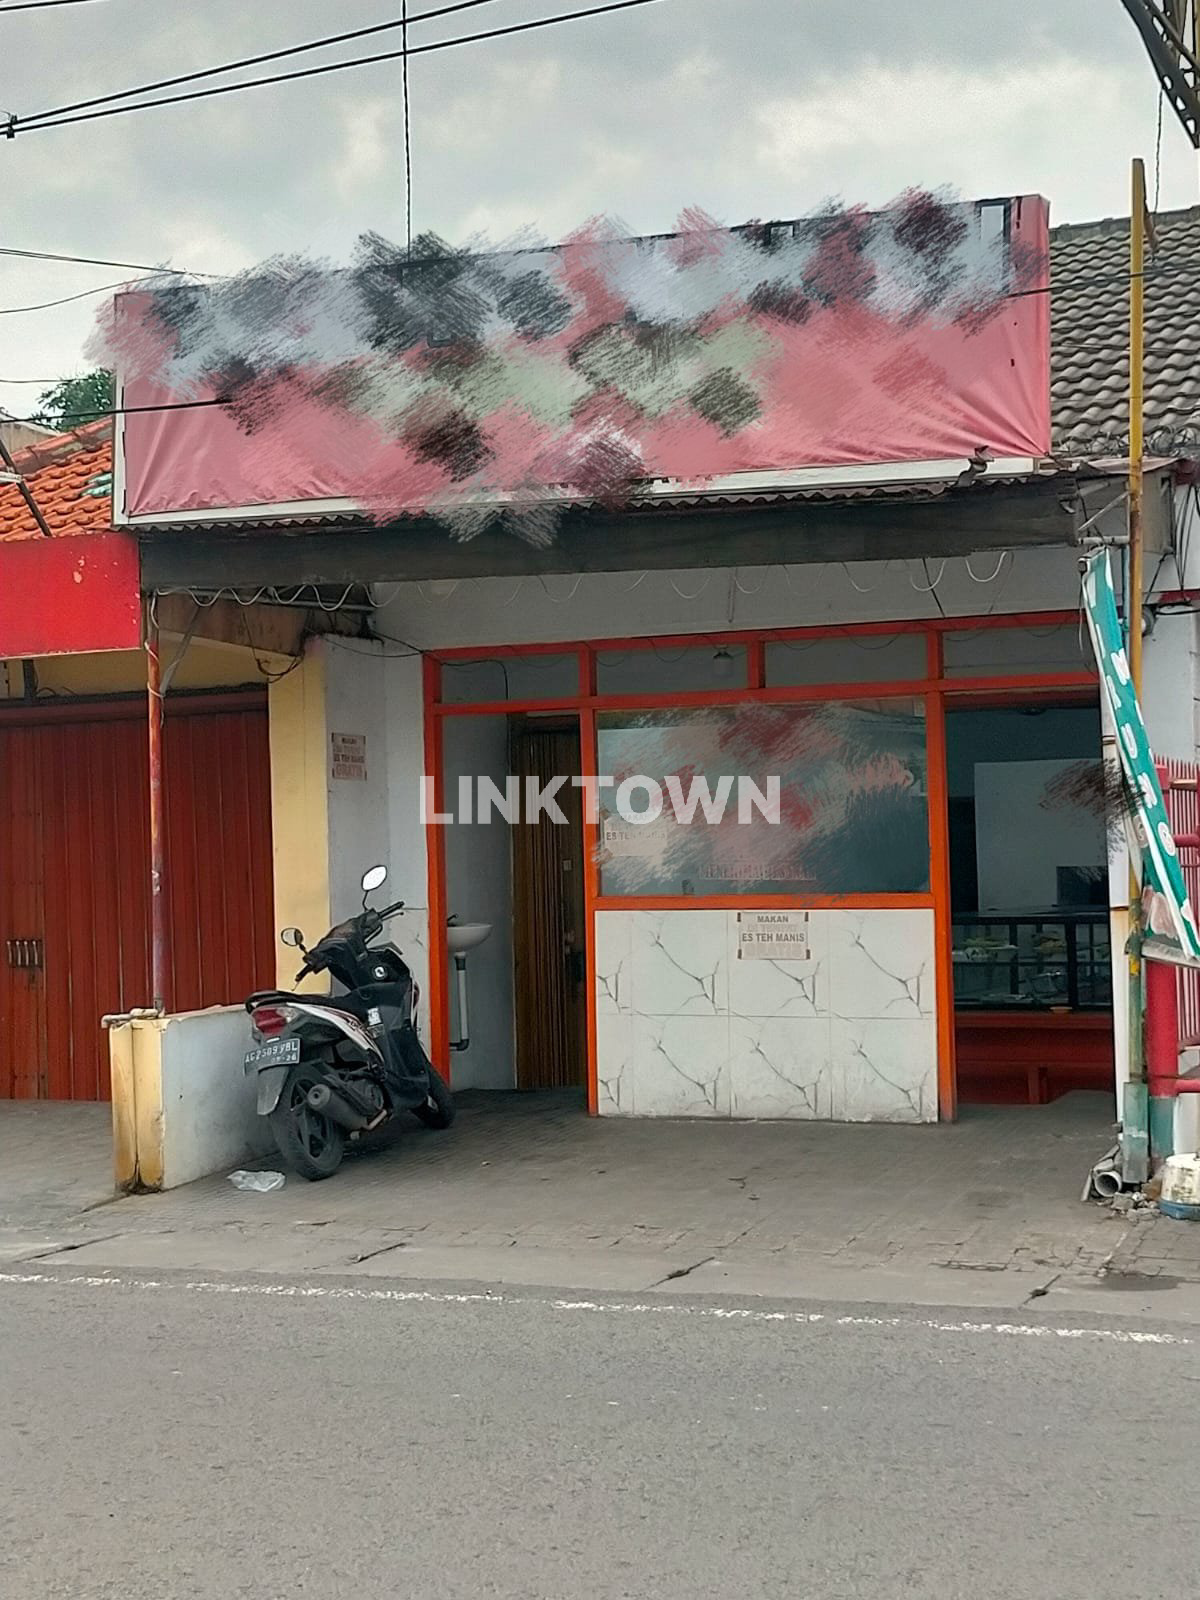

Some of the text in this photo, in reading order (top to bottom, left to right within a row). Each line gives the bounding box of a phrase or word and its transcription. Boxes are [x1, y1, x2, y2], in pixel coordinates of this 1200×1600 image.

[606, 832, 617, 841] ES
[757, 915, 789, 923] MAKAN
[742, 932, 805, 942] ES TEH MANIS
